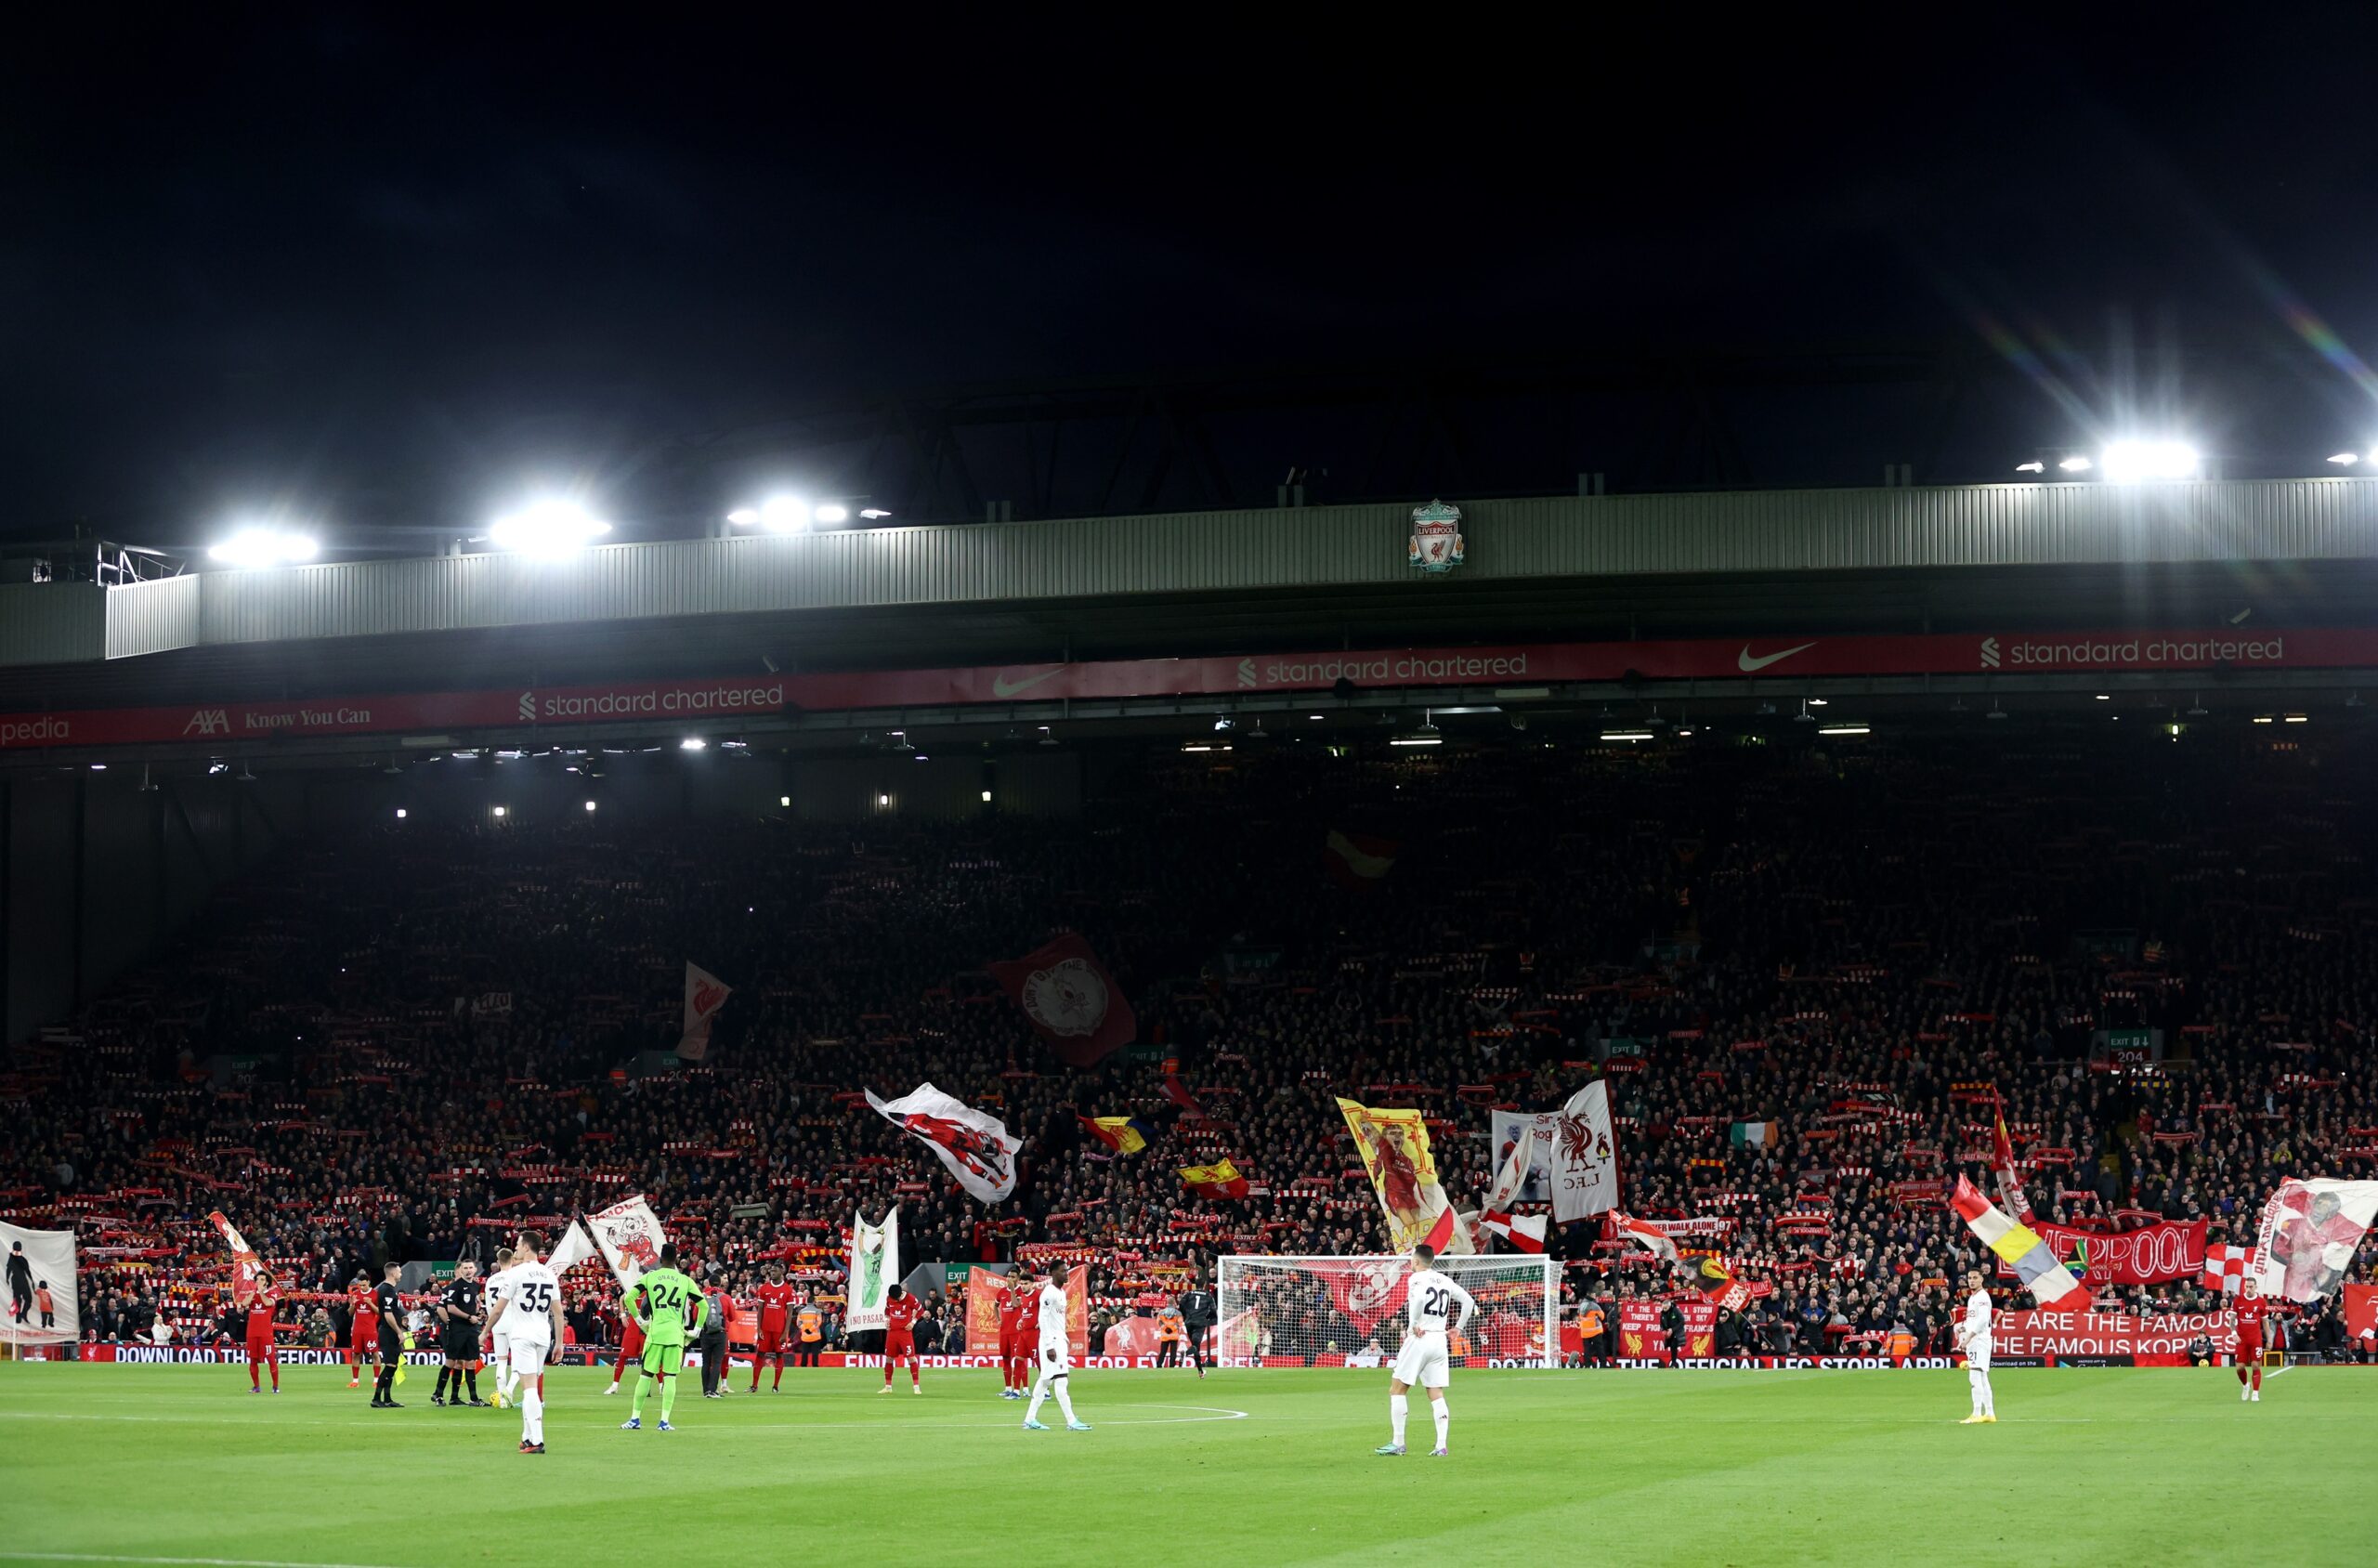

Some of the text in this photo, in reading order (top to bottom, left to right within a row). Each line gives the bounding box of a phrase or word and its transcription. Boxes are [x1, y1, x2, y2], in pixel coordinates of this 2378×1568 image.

[2011, 637, 2282, 663] standard chartered
[1266, 653, 1526, 683] standard chartered
[545, 684, 783, 716] standard chartered
[183, 709, 230, 736] AXA
[245, 708, 371, 729] Know You Can
[1, 716, 70, 743] pedia
[2110, 1038, 2129, 1046] EXIT
[2118, 1051, 2144, 1062] 204
[1536, 1115, 1553, 1125] Sir
[1668, 1222, 1690, 1232] WALK
[1692, 1221, 1717, 1231] ALONE
[1718, 1220, 1731, 1231] 97
[658, 1274, 679, 1283] ONANA
[947, 1272, 967, 1280] EXIT
[519, 1283, 554, 1313] 35
[653, 1284, 682, 1312] 24
[1194, 1295, 1200, 1310] 1
[1423, 1287, 1450, 1318] 20
[2025, 1312, 2074, 1331] ARE
[2083, 1313, 2131, 1333] THE
[2140, 1310, 2237, 1333] FAMOUS
[266, 1345, 271, 1353] 11
[906, 1345, 912, 1354] 3
[1993, 1337, 2025, 1354] HE
[2031, 1337, 2131, 1354] FAMOUS
[277, 1349, 341, 1365] FFICIAL
[1031, 1349, 1038, 1358] 7
[1084, 1355, 1129, 1367] FOR
[1968, 1352, 1977, 1362] 21
[1616, 1358, 1659, 1368] THE
